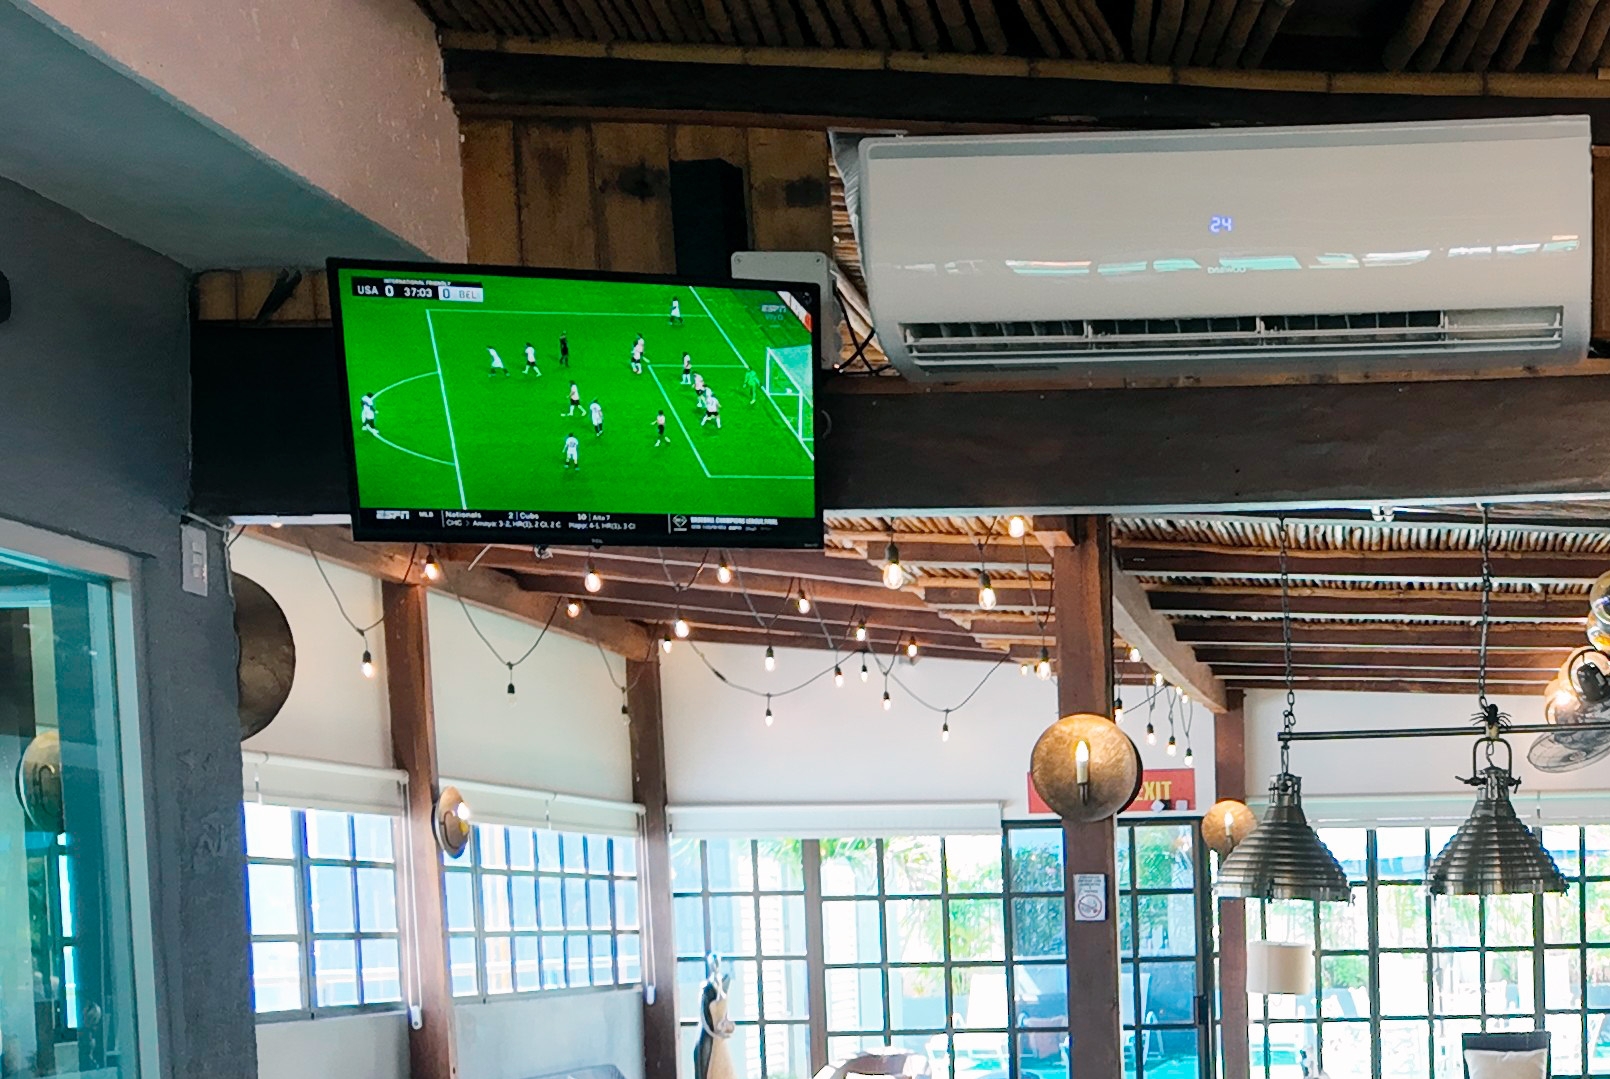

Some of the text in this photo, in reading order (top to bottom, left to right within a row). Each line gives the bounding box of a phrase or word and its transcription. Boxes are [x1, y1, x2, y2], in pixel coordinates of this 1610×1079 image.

[1210, 216, 1232, 232] 24
[357, 285, 477, 299] USA 0 37:03 0 BEL
[376, 510, 410, 520] ESPN
[577, 513, 588, 521] 10
